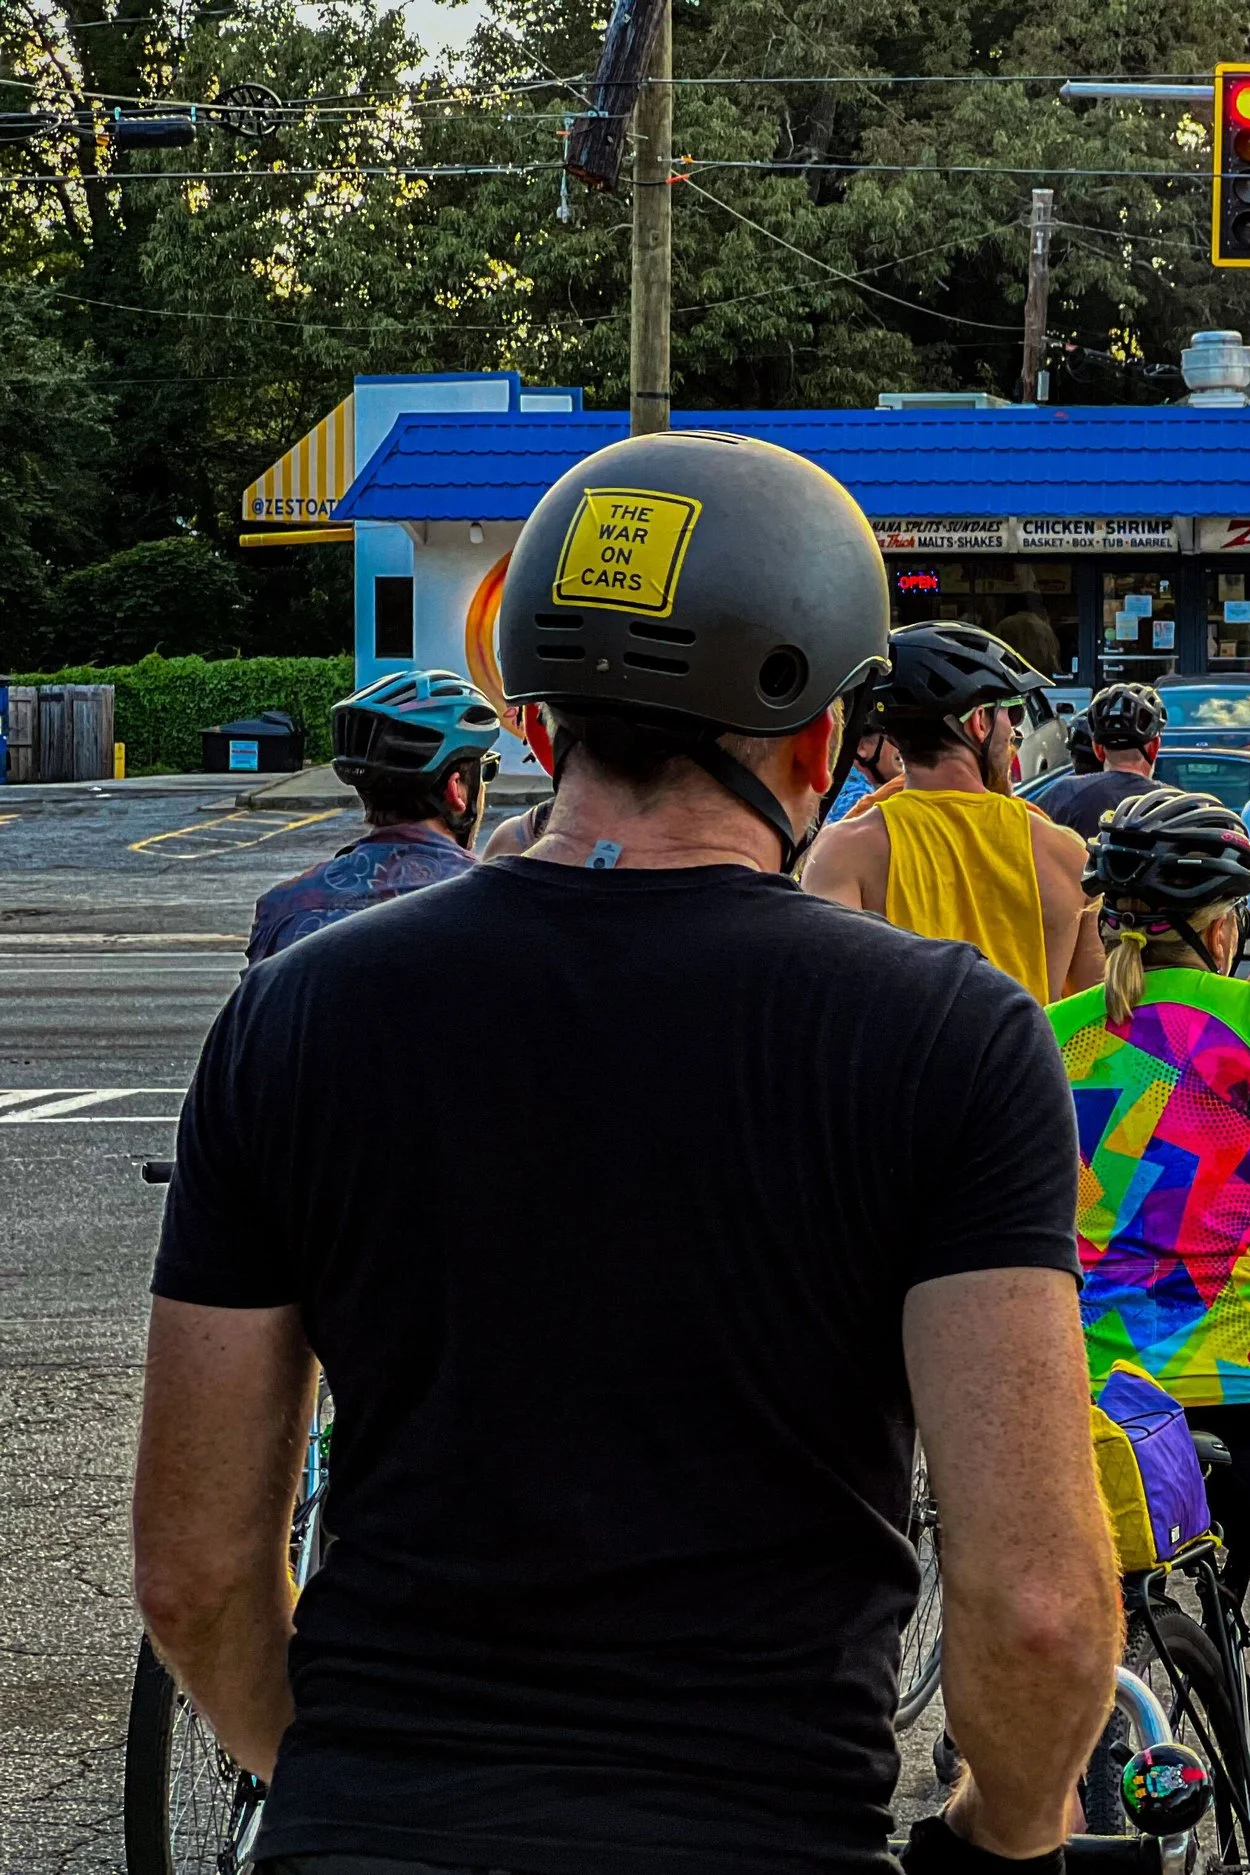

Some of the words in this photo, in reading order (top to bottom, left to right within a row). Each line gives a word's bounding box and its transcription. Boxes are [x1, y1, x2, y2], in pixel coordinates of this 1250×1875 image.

[252, 498, 341, 516] @ZESTOAT
[611, 504, 653, 523] THE
[599, 524, 648, 544] WAR
[1023, 520, 1095, 535] CHICKEN
[1105, 520, 1173, 535] SHRIMP
[1023, 538, 1064, 548] BASKET
[1072, 538, 1095, 548] BOX
[1102, 538, 1124, 548] TUB
[1130, 538, 1173, 548] BARREL
[601, 546, 632, 565] ON
[581, 568, 642, 591] CARS
[900, 575, 937, 589] OPEN
